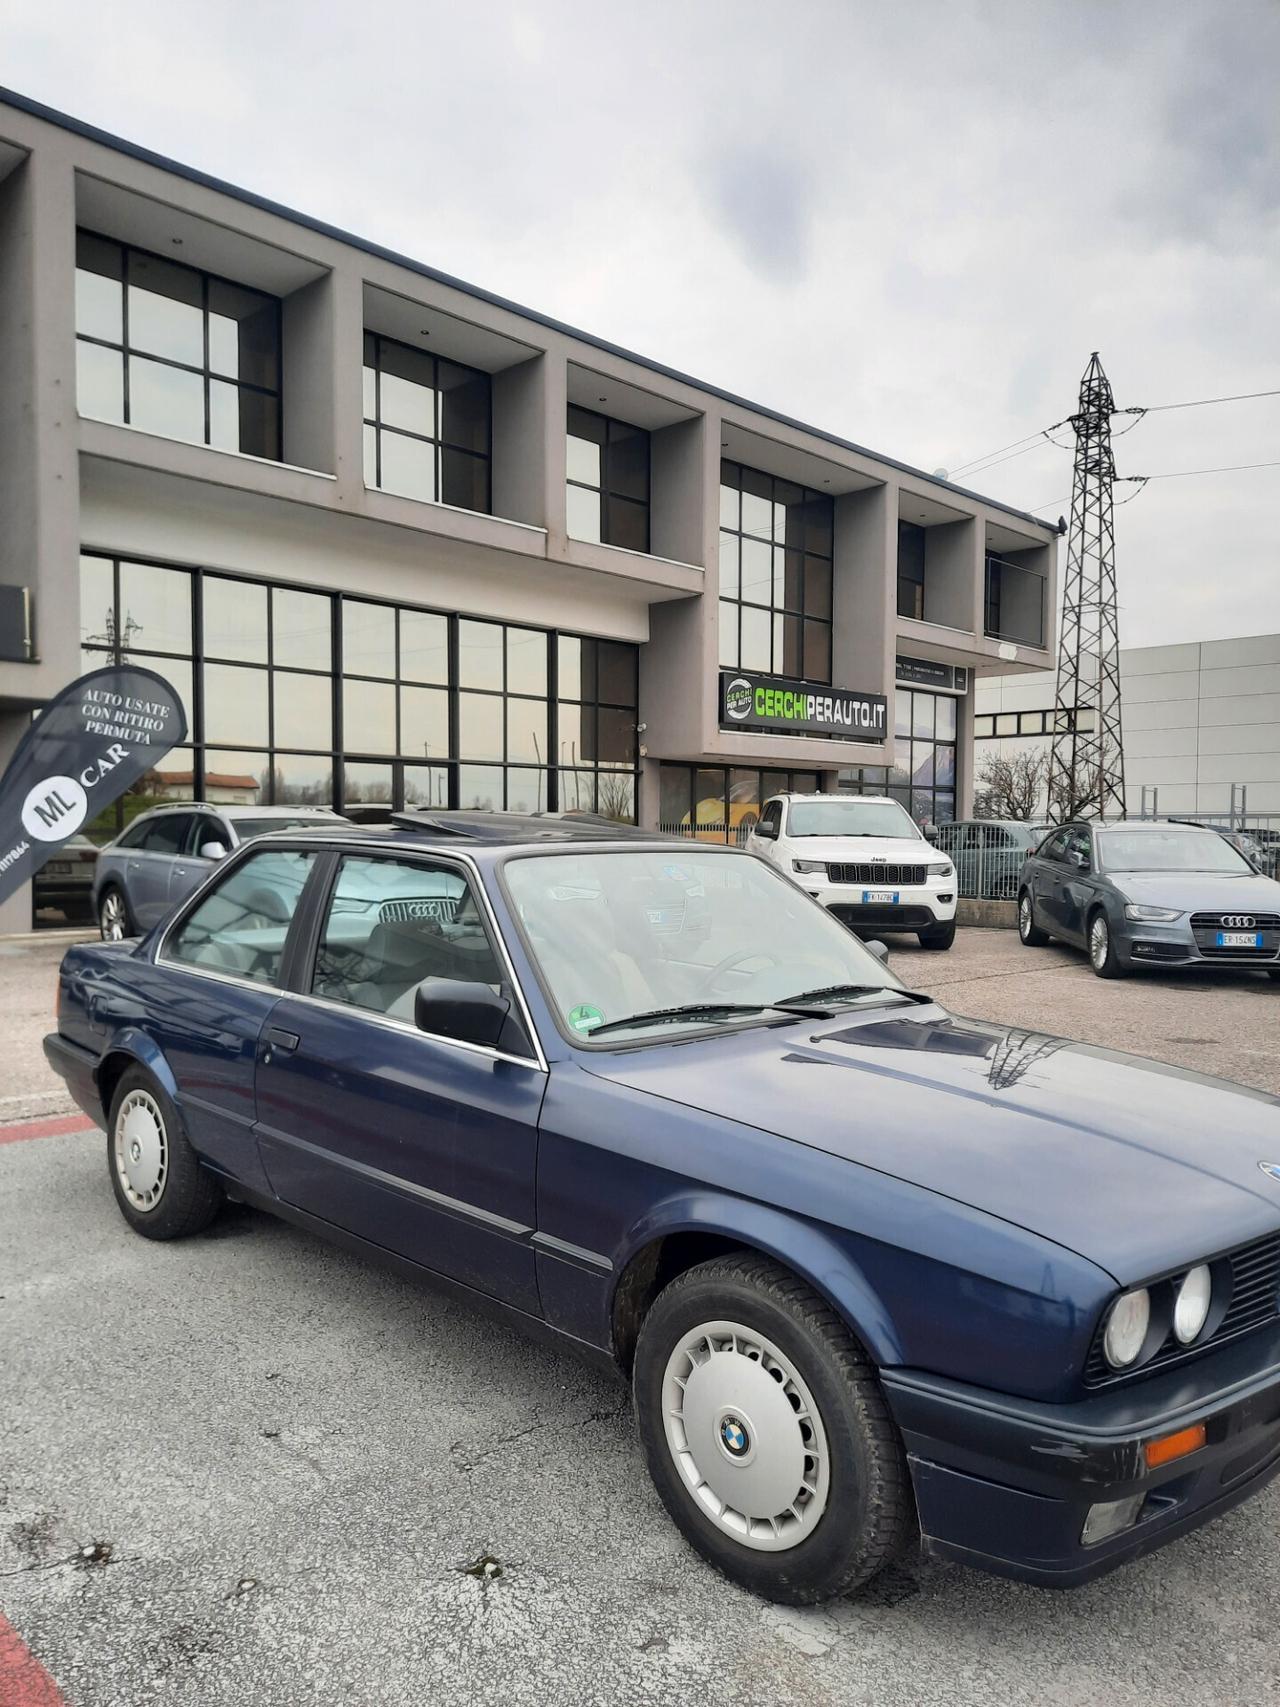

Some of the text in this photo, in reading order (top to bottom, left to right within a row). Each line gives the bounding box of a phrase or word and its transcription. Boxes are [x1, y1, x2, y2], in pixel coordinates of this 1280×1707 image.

[83, 689, 170, 718] AUTO USATE
[82, 704, 164, 732] CON RITIRO
[85, 720, 152, 745] PERMUTA
[33, 743, 130, 828] ML CAR
